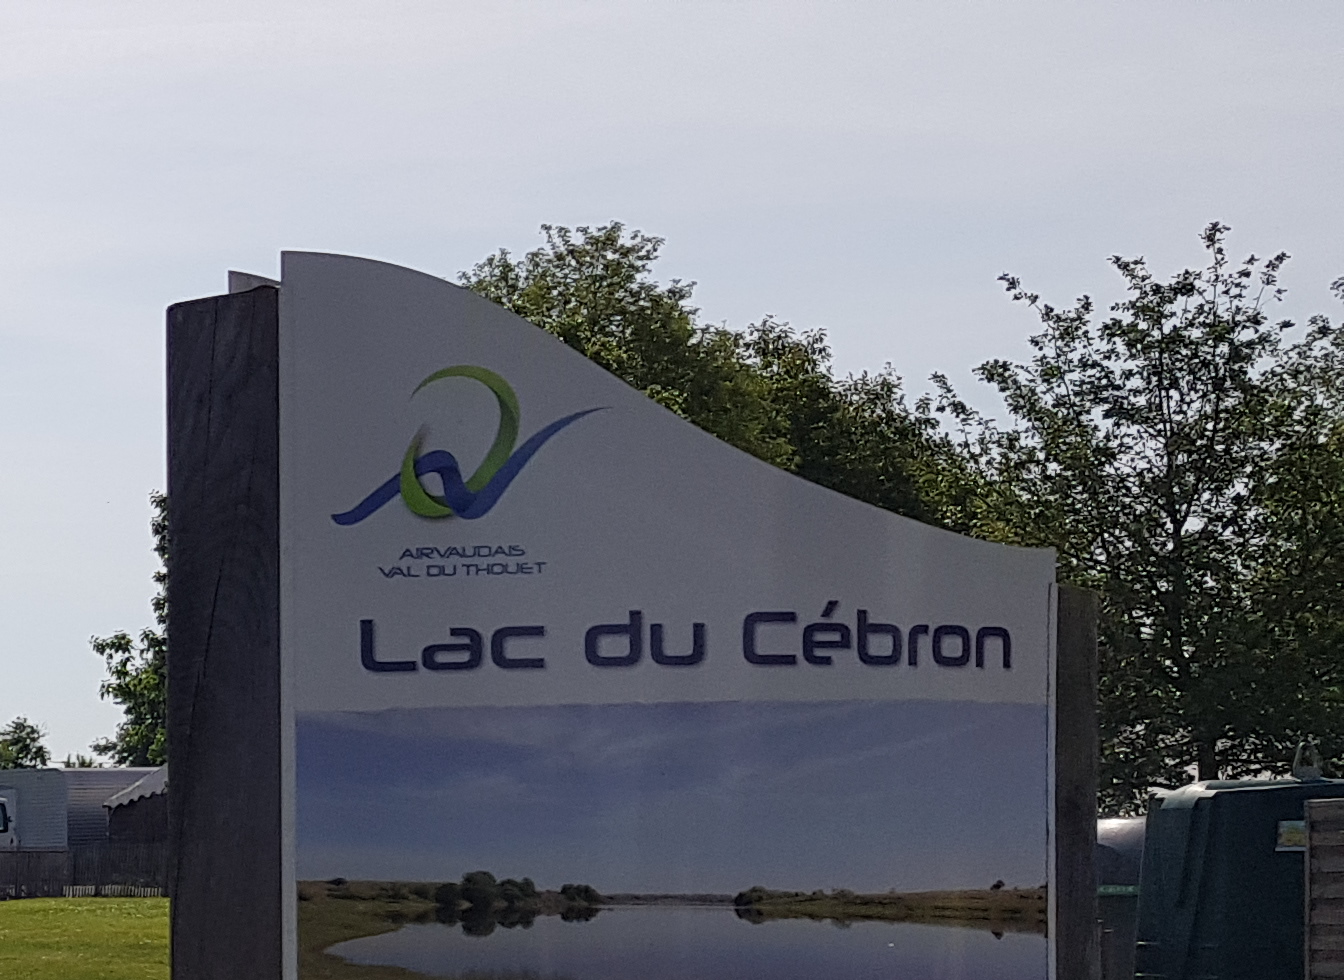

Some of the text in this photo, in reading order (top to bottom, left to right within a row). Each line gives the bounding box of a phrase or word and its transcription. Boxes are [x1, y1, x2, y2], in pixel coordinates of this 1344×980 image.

[398, 544, 527, 561] AIRVAUDAIS
[377, 561, 548, 579] VAL DU THOUET
[359, 600, 1013, 674] Lac du Cébron
